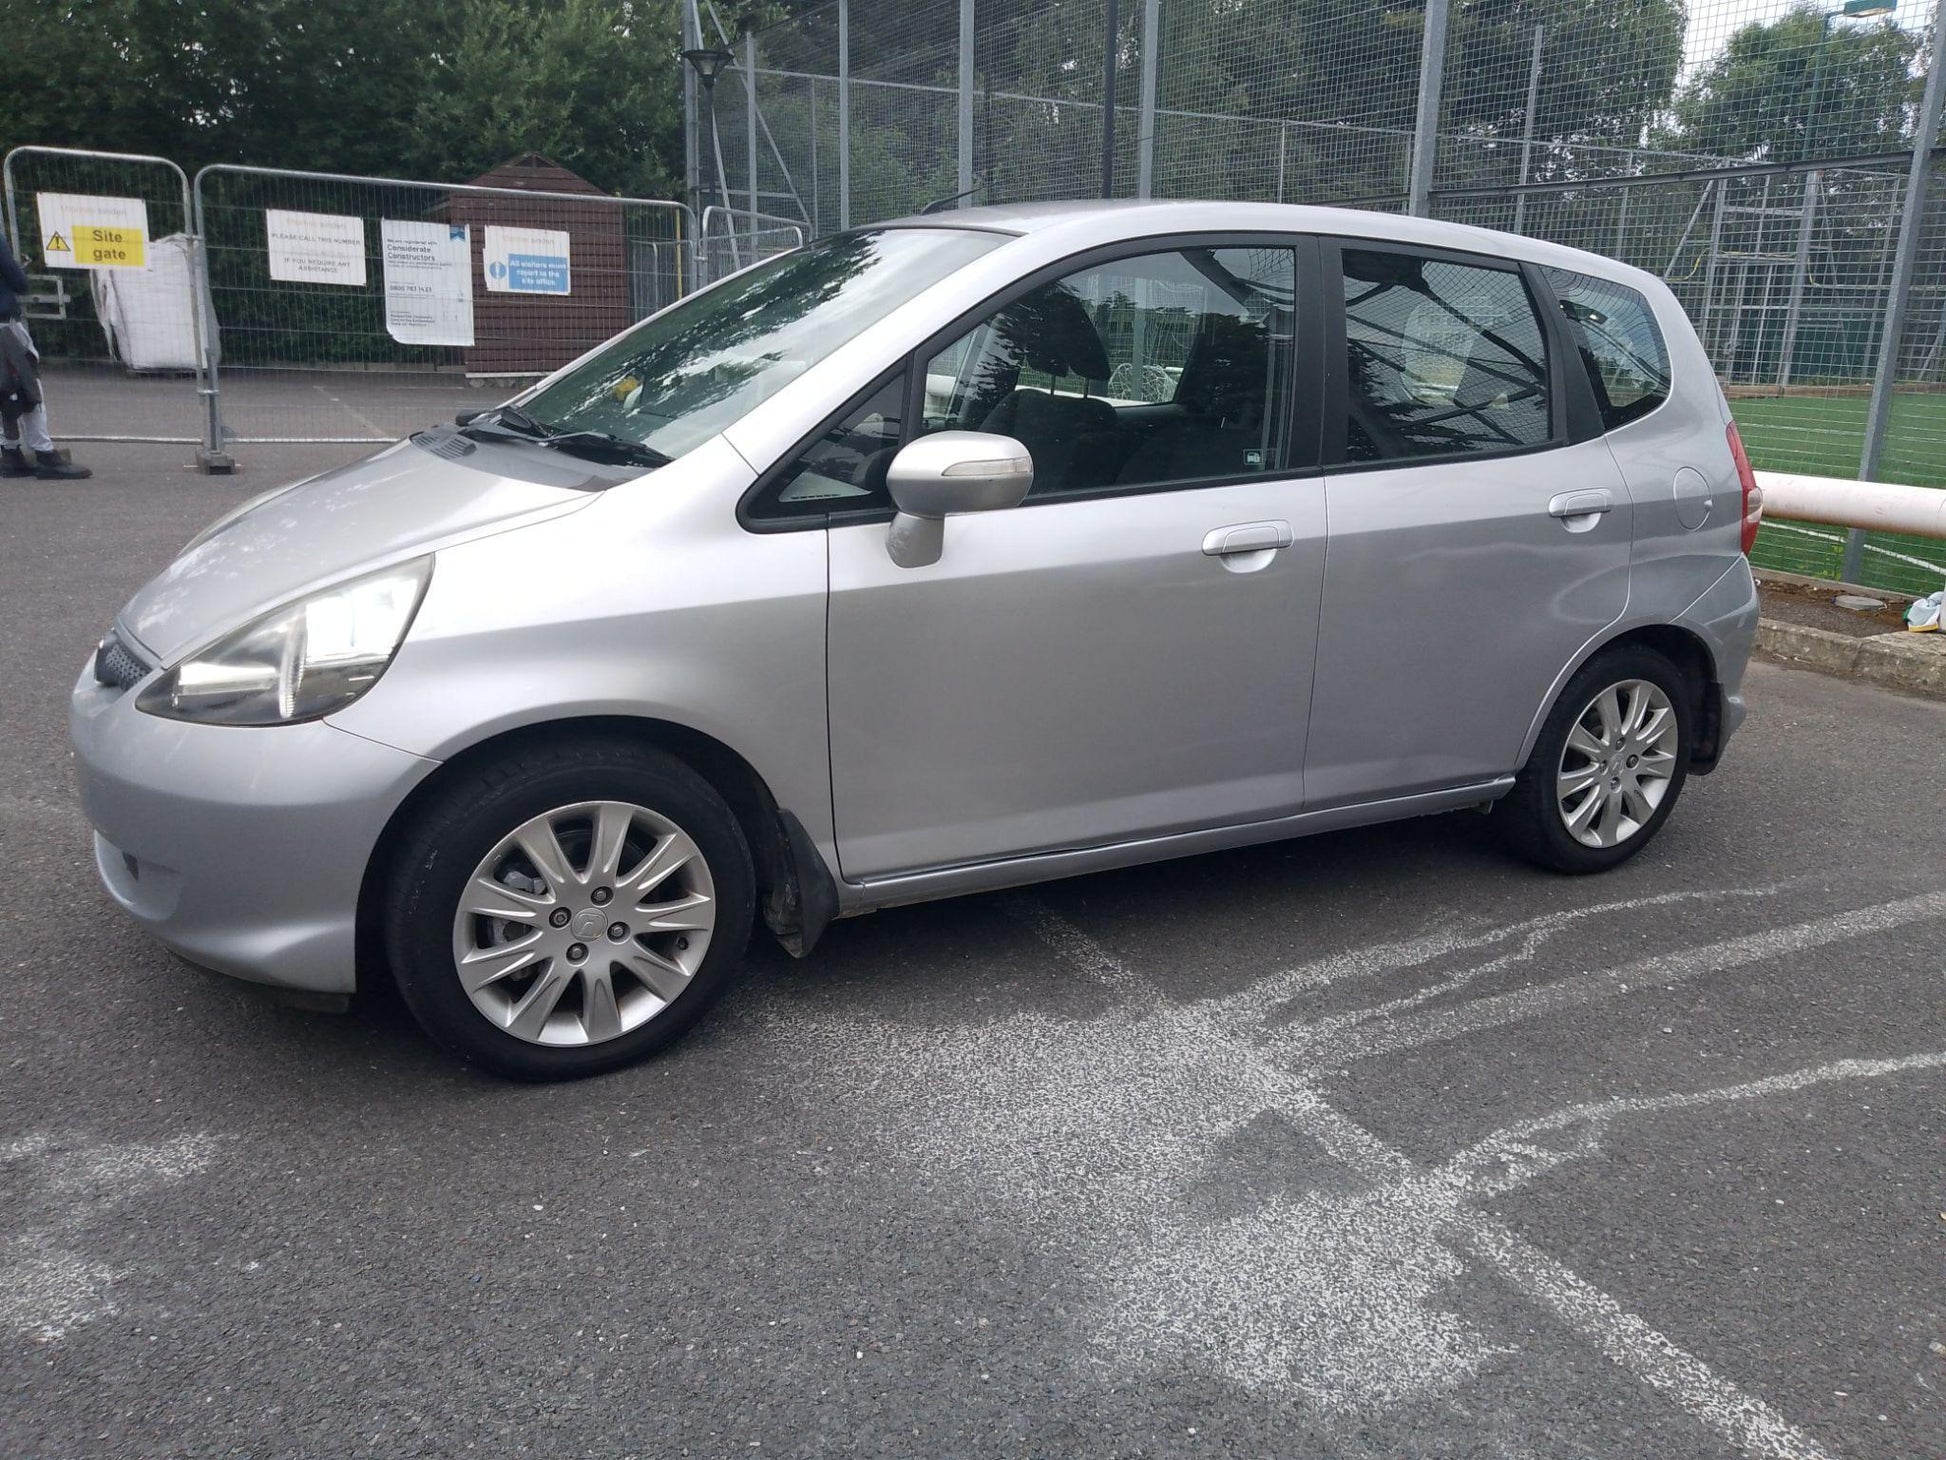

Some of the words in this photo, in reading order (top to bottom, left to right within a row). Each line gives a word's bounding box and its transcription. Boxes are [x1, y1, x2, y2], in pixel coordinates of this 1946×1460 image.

[92, 229, 123, 243] Site
[387, 244, 432, 253] Considerate
[93, 248, 127, 262] gate
[388, 252, 436, 261] Constructors
[292, 257, 306, 265] YOU
[521, 260, 547, 269] visitors
[298, 265, 338, 273] ASSISTANCE
